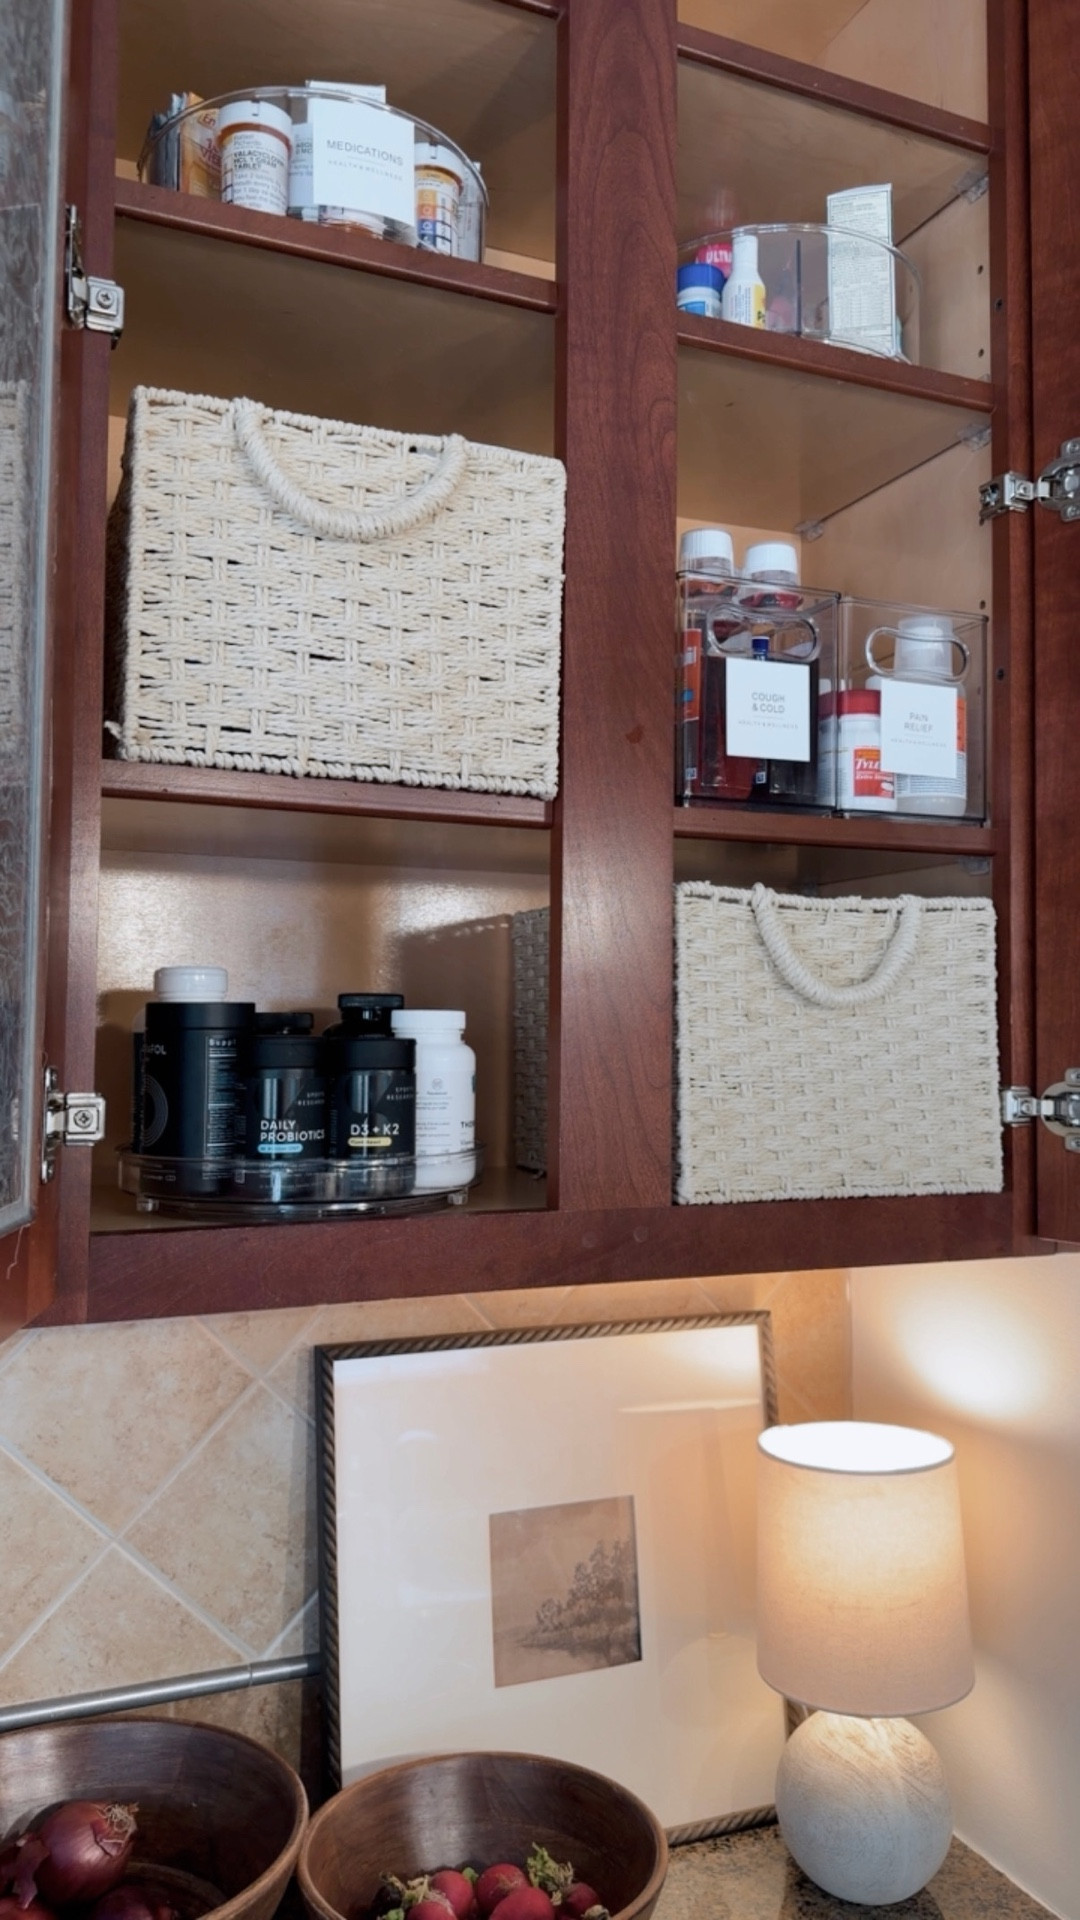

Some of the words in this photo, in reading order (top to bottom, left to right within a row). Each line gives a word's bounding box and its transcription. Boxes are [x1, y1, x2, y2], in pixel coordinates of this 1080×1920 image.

[326, 139, 404, 167] MEDICATIONS
[752, 692, 786, 703] COUGH
[760, 704, 785, 714] COLD
[909, 712, 929, 722] PAIN
[904, 722, 933, 733] RELIEF
[260, 1120, 296, 1130] DAILY
[350, 1123, 369, 1135] D3
[372, 1126, 379, 1134] +
[383, 1123, 399, 1135] K2
